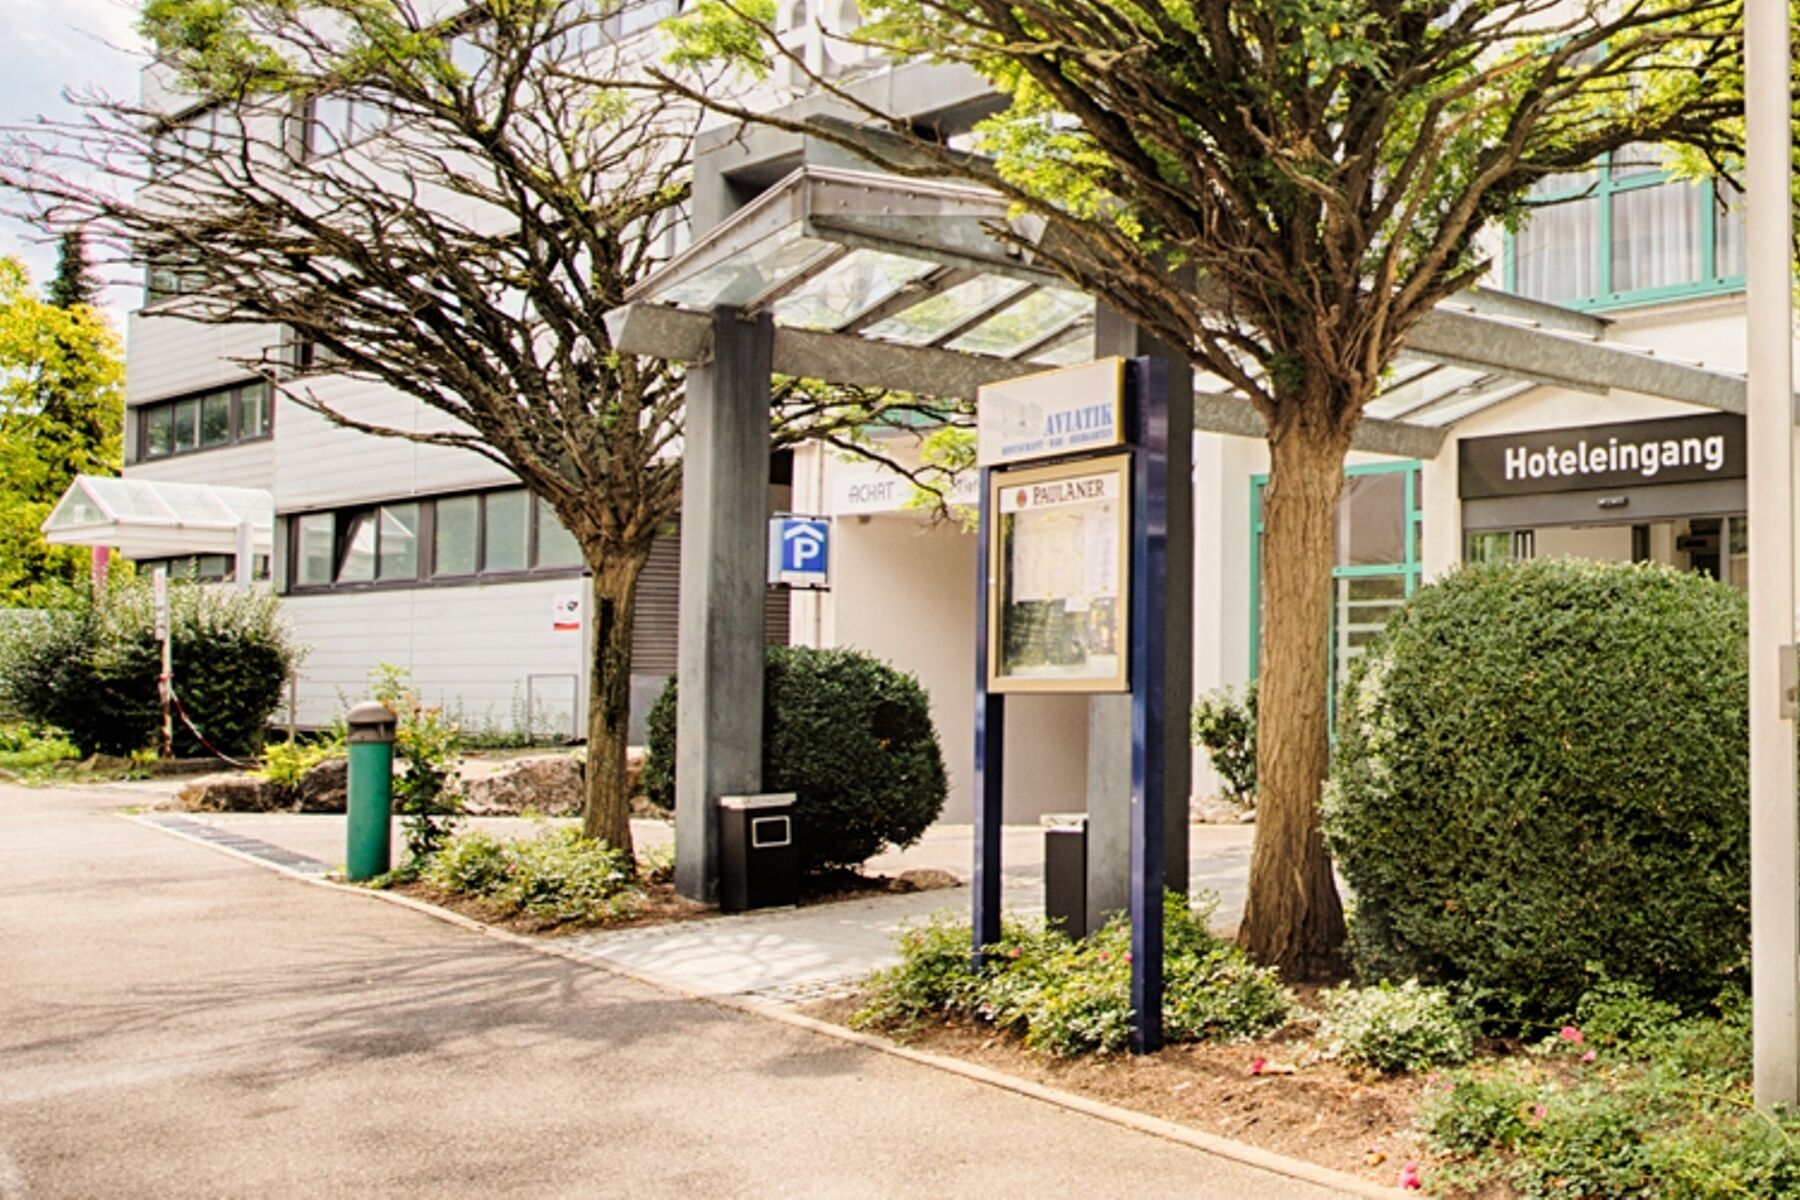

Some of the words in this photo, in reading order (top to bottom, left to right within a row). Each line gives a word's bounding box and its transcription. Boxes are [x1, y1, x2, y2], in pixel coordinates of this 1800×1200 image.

[1044, 402, 1113, 436] AVIATIK
[1504, 434, 1725, 481] Hoteleingang
[848, 481, 896, 504] ACHAT
[1033, 478, 1105, 506] PAULANER
[793, 537, 820, 569] P
